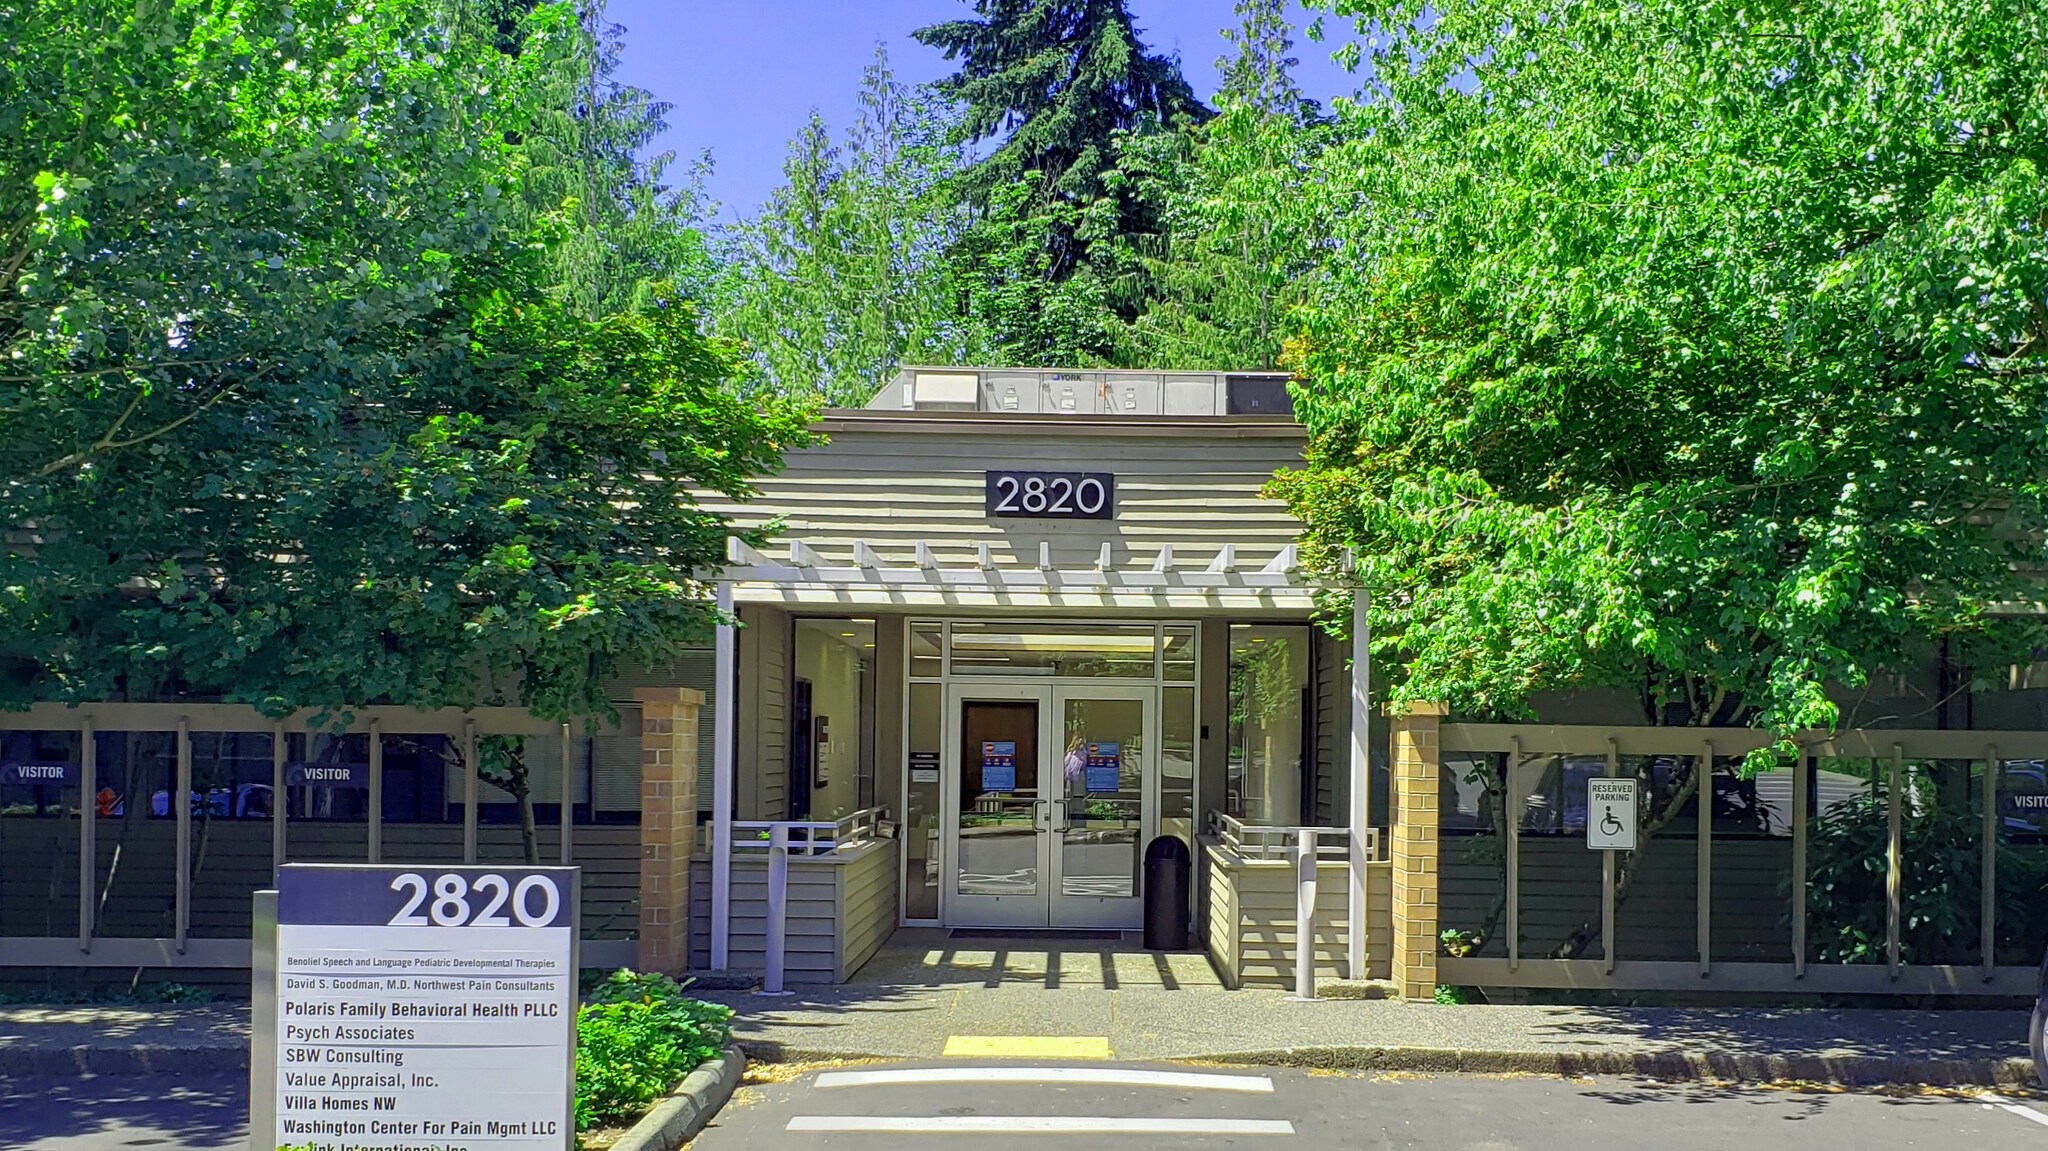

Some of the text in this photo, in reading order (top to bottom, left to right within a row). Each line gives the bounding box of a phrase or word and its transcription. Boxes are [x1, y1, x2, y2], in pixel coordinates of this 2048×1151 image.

[1060, 374, 1082, 382] YORK
[994, 476, 1105, 514] 2820
[17, 765, 65, 778] VISITOR
[304, 767, 351, 780] VISITOR
[1592, 784, 1633, 793] RESERVED
[1595, 793, 1630, 802] PARKING
[387, 873, 560, 928] 2820
[287, 957, 556, 970] Benoliel Speech and Language Pediatric Developmental Therapies
[287, 978, 555, 992] David S. Goodman, M.D. Northwest Pain Consultants
[286, 1001, 558, 1020] Polaris Family Behavioral Health PLLC
[287, 1024, 415, 1043] Psych Associates
[286, 1048, 404, 1067] SBW Consulting
[285, 1072, 439, 1090] Value Appraisal, Inc.
[285, 1095, 397, 1111] Villa Homes NW
[283, 1119, 557, 1138] Washington Center For Pain Mgmt LLC
